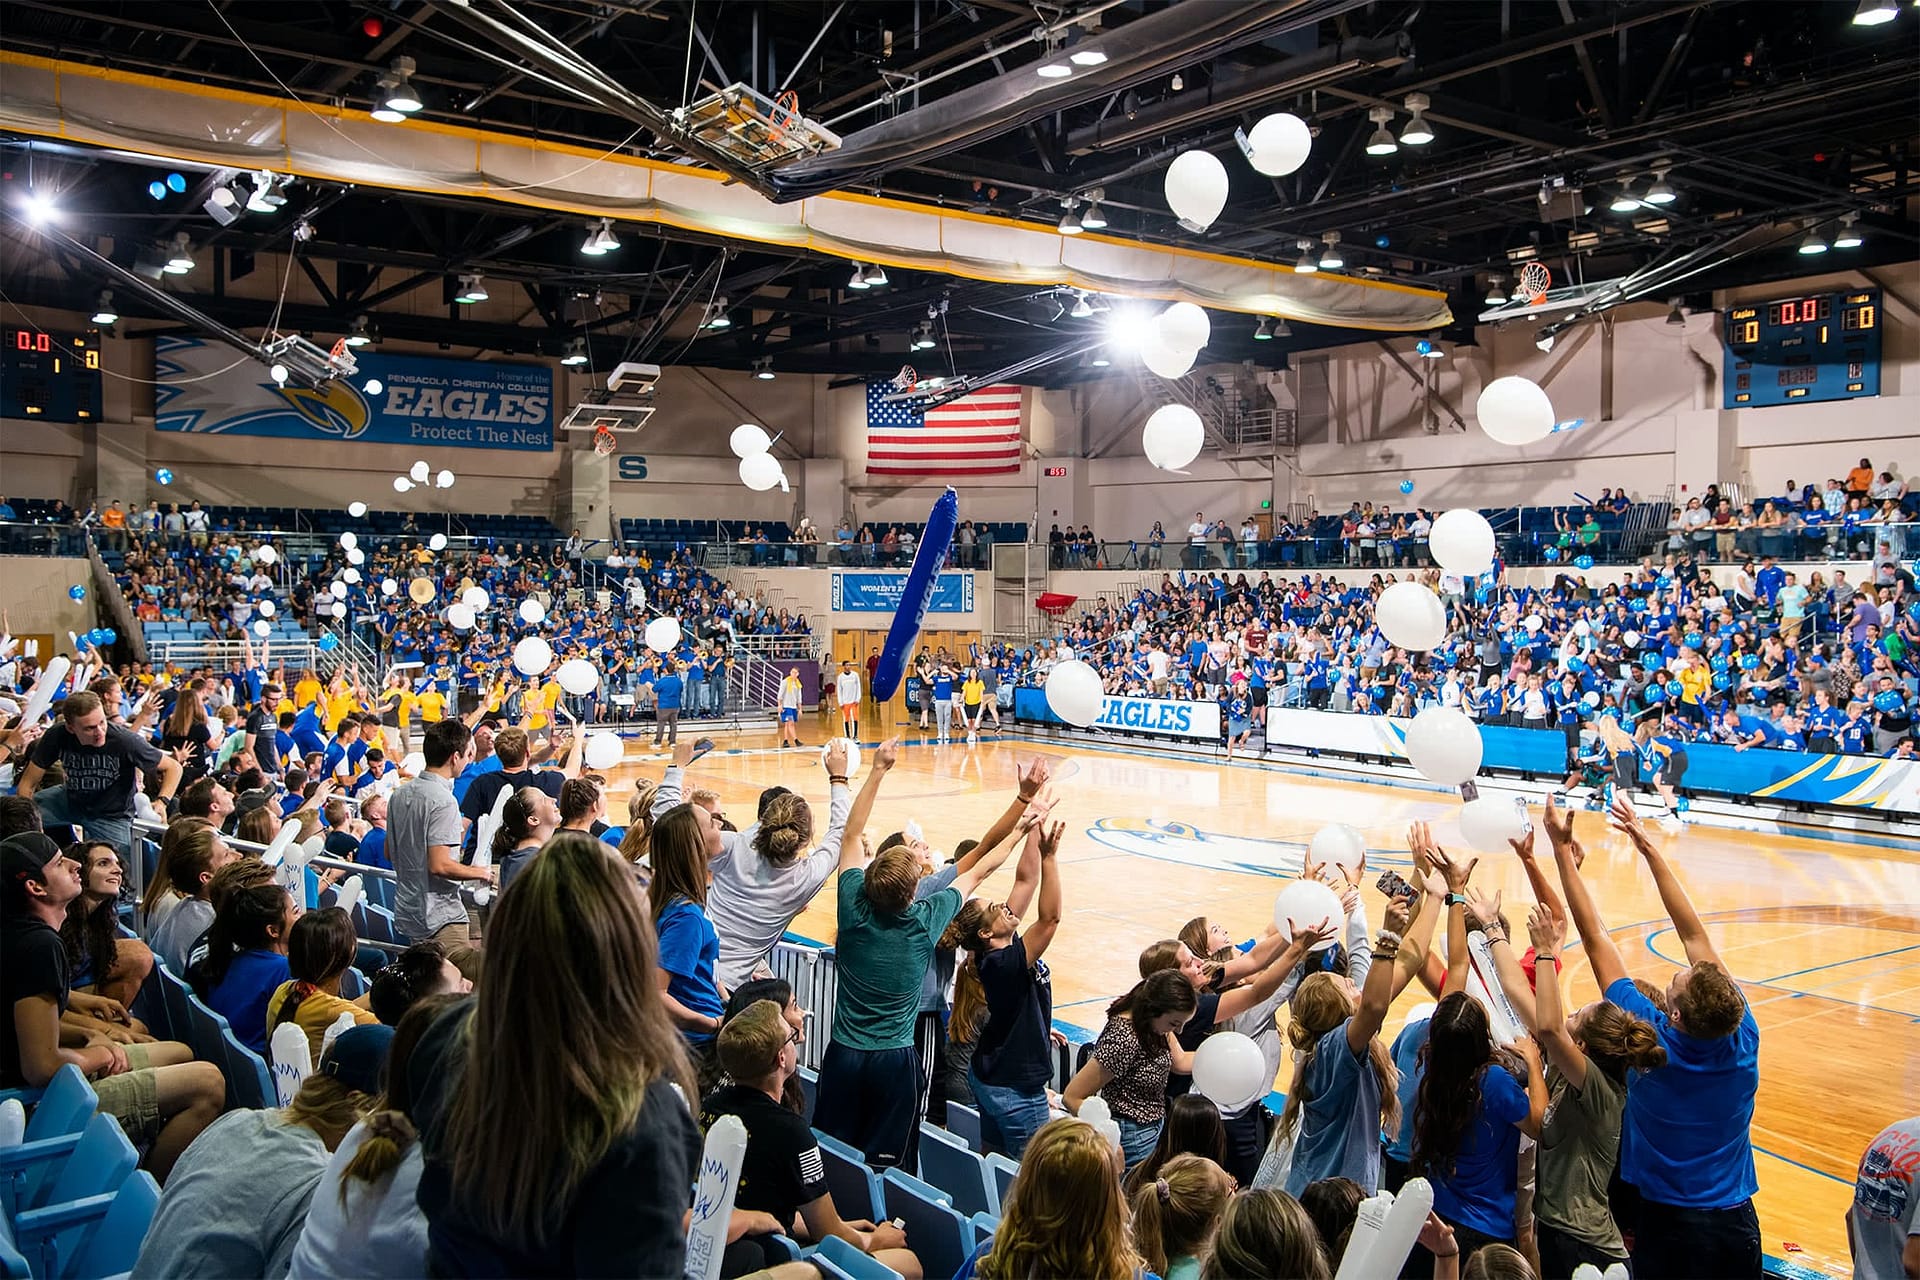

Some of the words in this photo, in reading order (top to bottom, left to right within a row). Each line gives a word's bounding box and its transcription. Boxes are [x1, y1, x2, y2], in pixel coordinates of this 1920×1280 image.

[1781, 300, 1816, 325] 0.0
[1859, 306, 1874, 329] 0
[17, 331, 50, 352] 0.0
[1744, 321, 1759, 343] 0
[387, 373, 449, 386] PENSACOLA
[452, 378, 505, 390] CHRISTIAN
[507, 383, 549, 394] COLLEGE
[496, 371, 523, 382] Home
[524, 373, 534, 383] of
[535, 374, 550, 385] the
[382, 385, 549, 425] EAGLES
[410, 421, 473, 441] Protect
[476, 425, 509, 444] The
[512, 428, 549, 446] Nest
